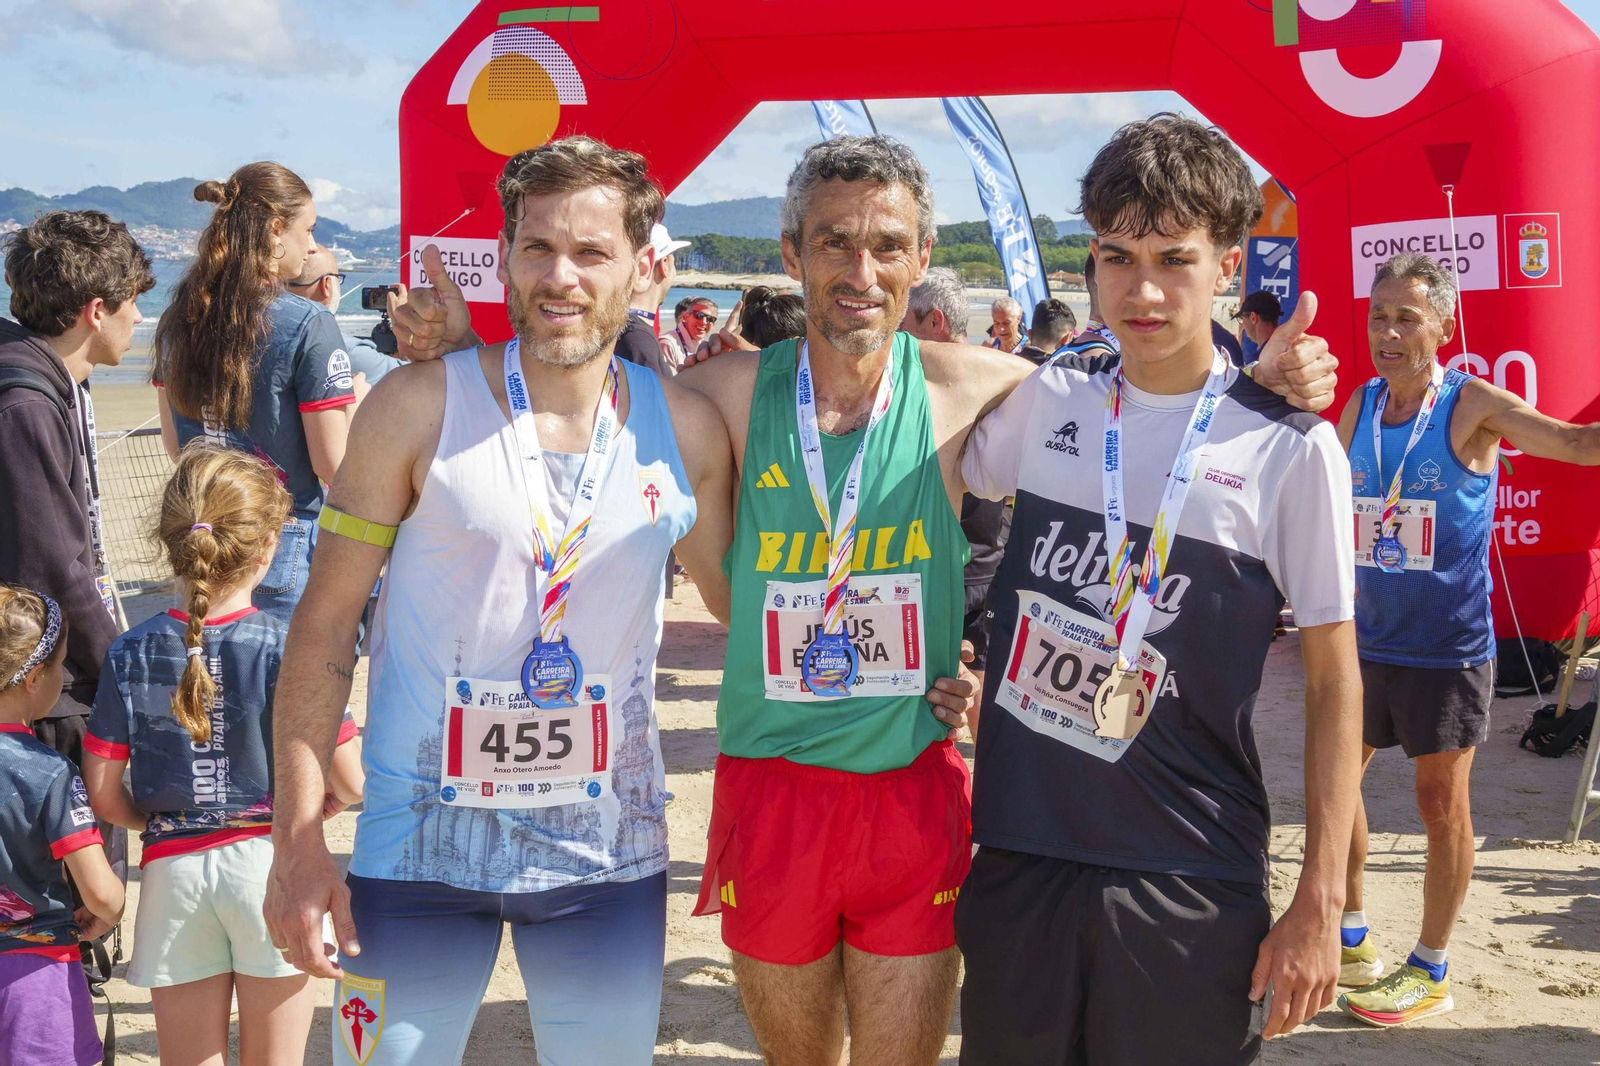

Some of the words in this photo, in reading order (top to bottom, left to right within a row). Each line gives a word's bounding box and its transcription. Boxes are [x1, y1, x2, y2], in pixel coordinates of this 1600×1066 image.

[1361, 232, 1485, 259] CONCELLO
[413, 249, 495, 268] CCELLO
[1438, 256, 1470, 275] GO
[511, 372, 528, 410] CARREIRA
[802, 368, 811, 405] CARREIRA
[1197, 393, 1217, 433] CARREIRA
[593, 415, 608, 454] CARREIRA
[1105, 430, 1114, 472] CARREIRA
[583, 476, 596, 489] FE
[1204, 472, 1243, 491] DELIKIA
[1107, 497, 1118, 511] FE
[1495, 485, 1541, 509] llor
[1373, 521, 1402, 543] 37
[1030, 521, 1191, 612] delia
[803, 594, 817, 606] FE
[820, 589, 860, 601] CIRA
[1052, 611, 1063, 629] FE
[1063, 620, 1105, 643] CARREIRA
[1061, 628, 1081, 643] PRAIA
[1082, 637, 1092, 646] DE
[792, 637, 890, 668] EÑA
[815, 657, 847, 665] CARREIRA
[536, 666, 570, 676] CARREIRA
[1032, 638, 1110, 704] 705
[213, 696, 224, 712] DE
[492, 693, 505, 706] FE
[508, 702, 530, 710] PRAIA
[1034, 684, 1042, 694] Luis
[1055, 695, 1089, 713] Consuegra
[1041, 708, 1057, 720] 100
[212, 712, 224, 751] PRAIA
[479, 718, 573, 763] 455
[213, 758, 227, 804] años
[493, 766, 511, 774] Anxo
[512, 765, 532, 773] Otero
[533, 764, 562, 772] Amoedo
[191, 759, 217, 805] 100
[517, 783, 534, 792] 100
[1393, 983, 1430, 1012] HOKA
